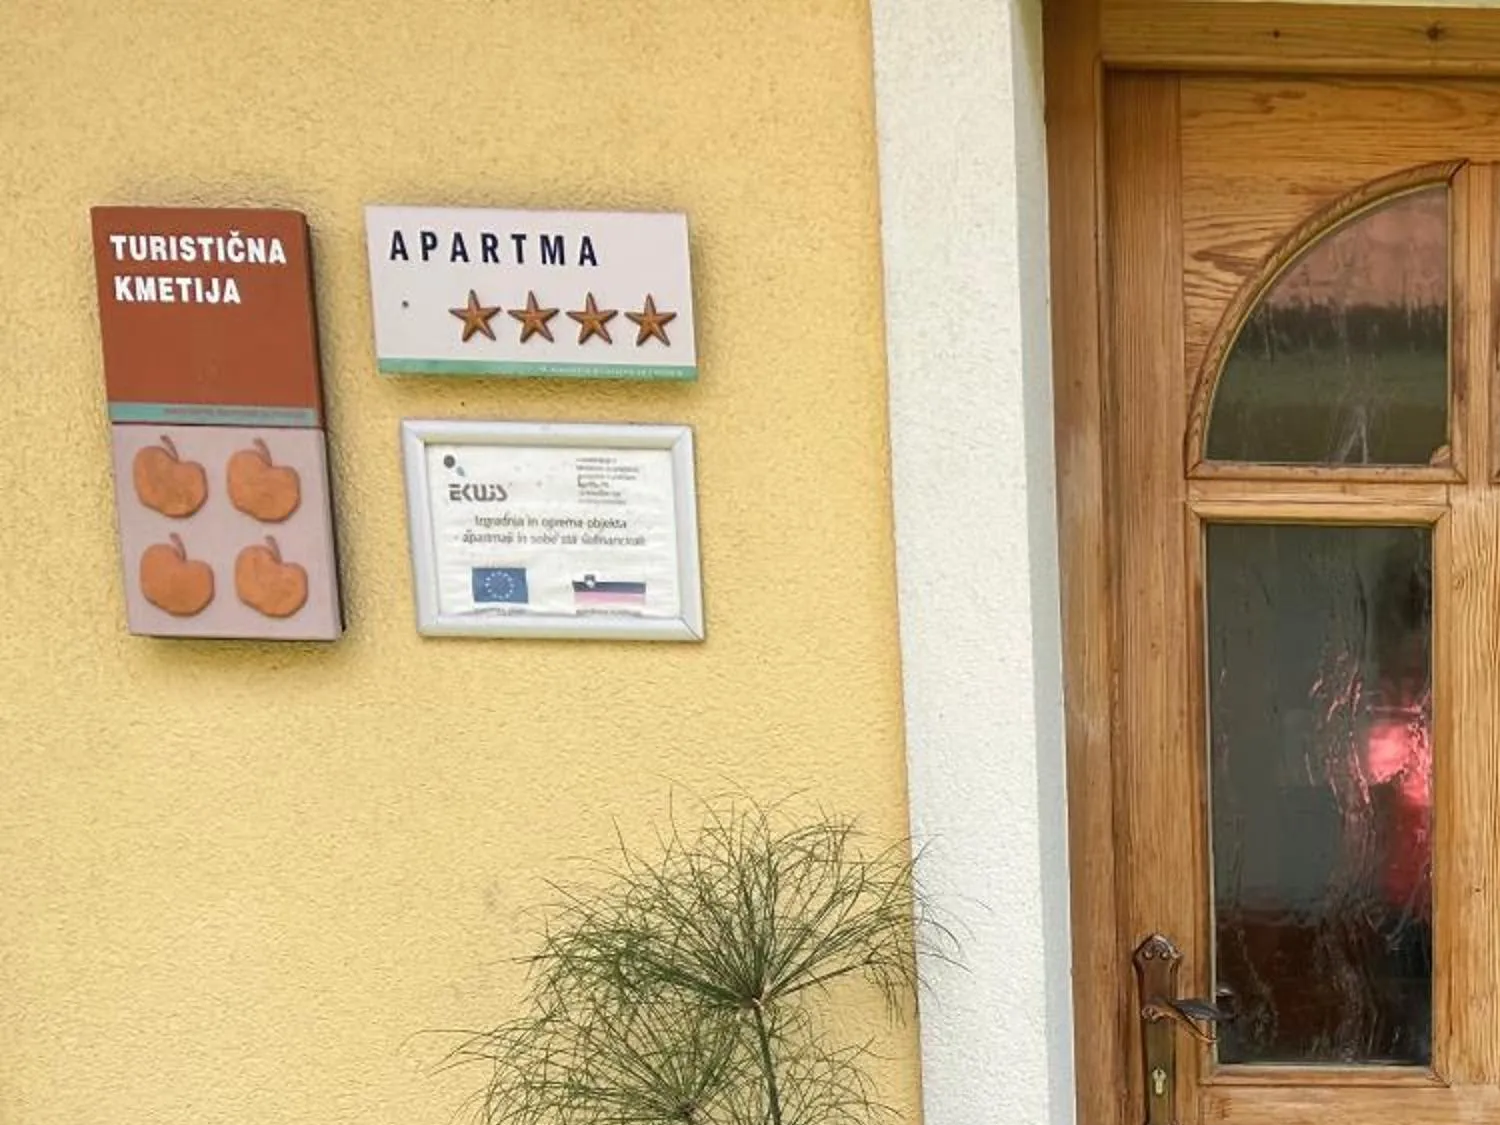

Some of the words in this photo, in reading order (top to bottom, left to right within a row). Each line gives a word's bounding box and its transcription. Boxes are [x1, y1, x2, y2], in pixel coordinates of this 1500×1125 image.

[109, 229, 288, 265] TURISTIČNA
[388, 229, 601, 268] APARTMA
[113, 275, 243, 305] KMETIJA
